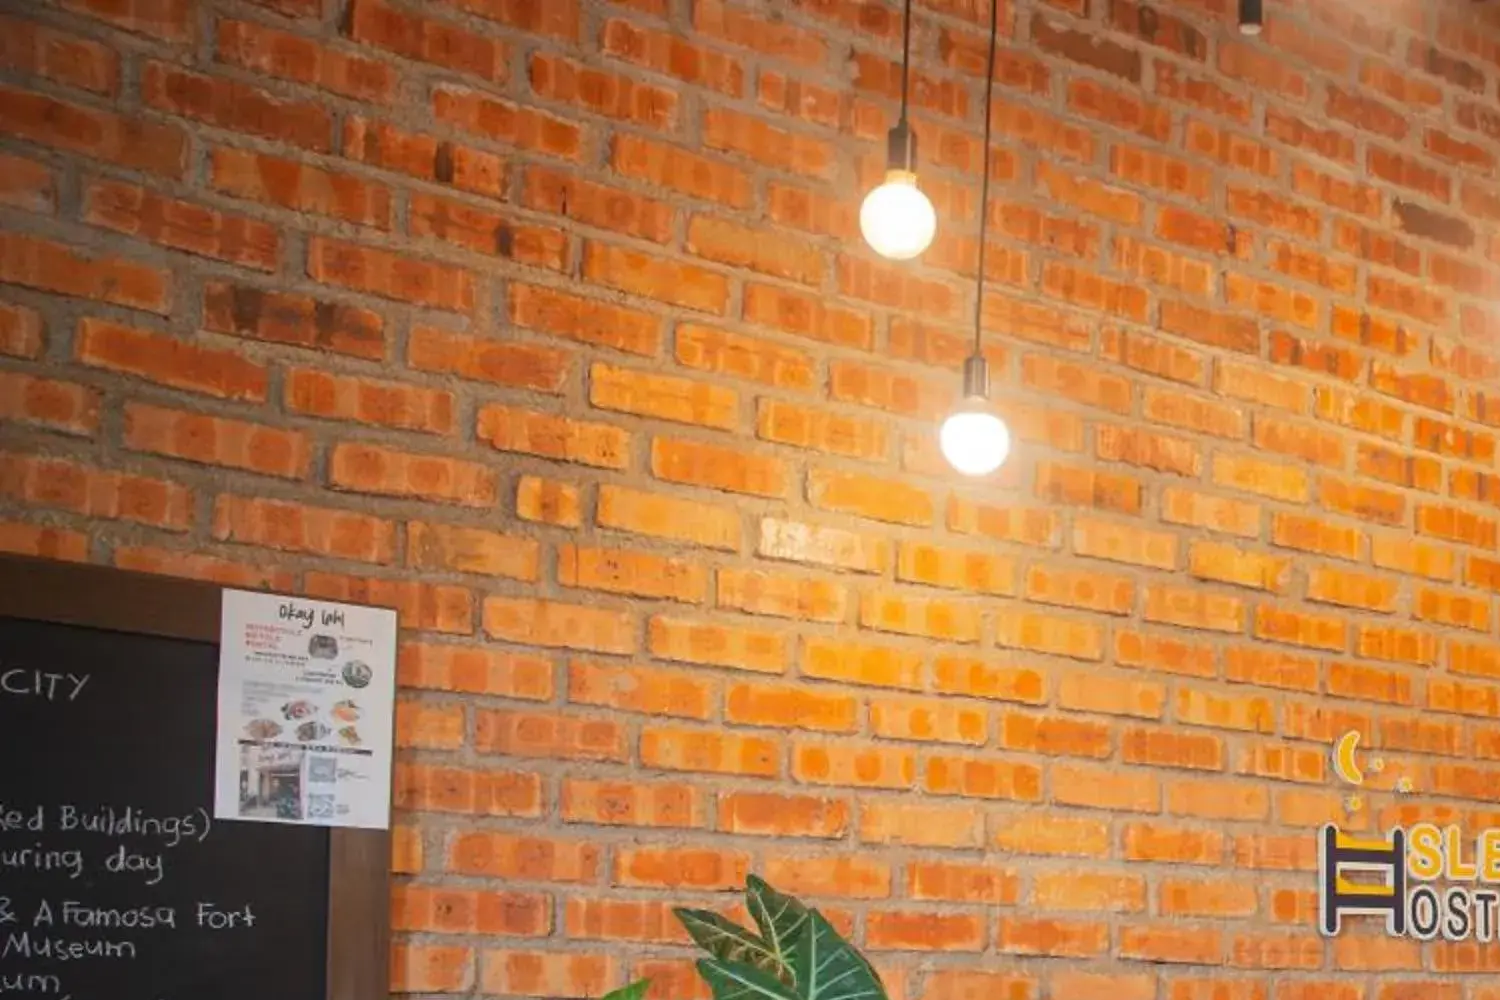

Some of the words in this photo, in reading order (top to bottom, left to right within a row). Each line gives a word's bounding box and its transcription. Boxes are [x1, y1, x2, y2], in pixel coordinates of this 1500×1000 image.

[1, 669, 90, 700] CITY
[60, 805, 211, 847] Buildings)
[105, 845, 163, 885] day
[197, 902, 256, 929] Fort
[1, 931, 136, 961] Museum
